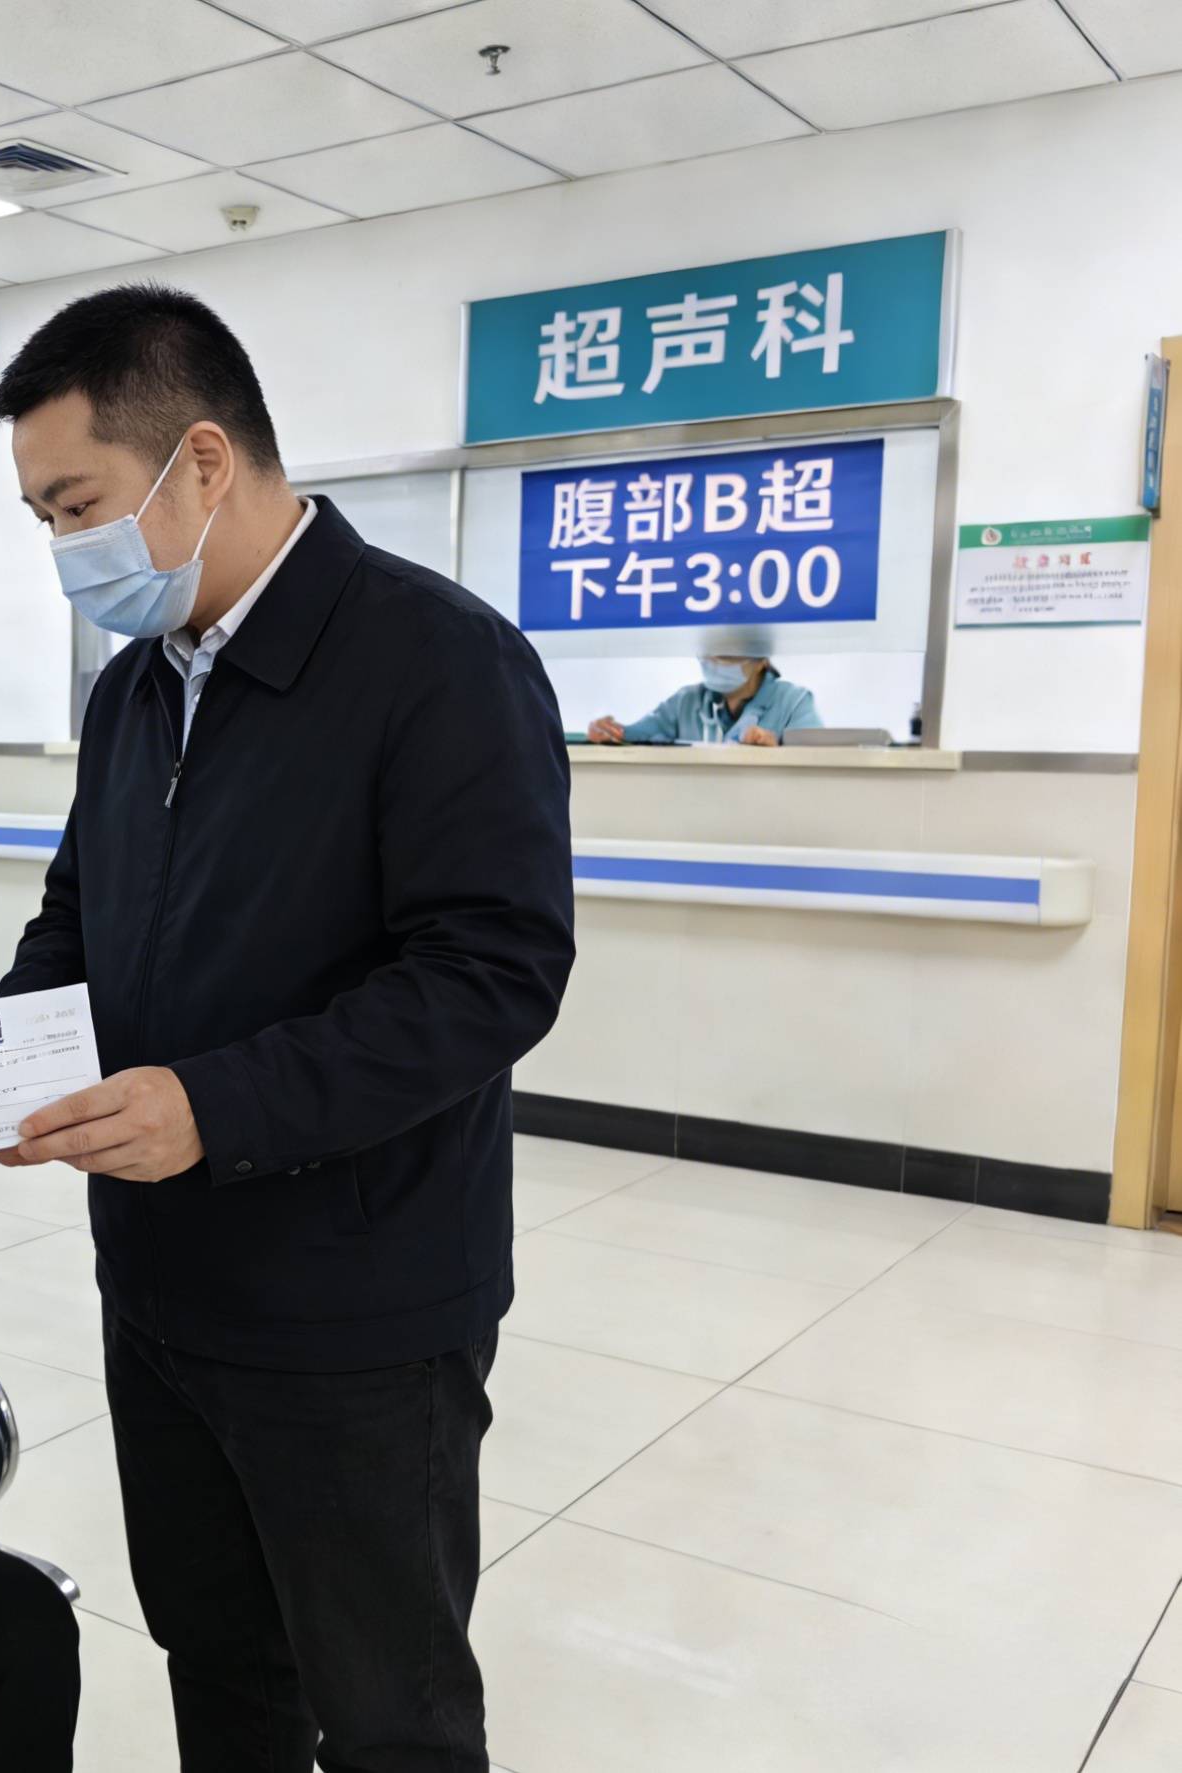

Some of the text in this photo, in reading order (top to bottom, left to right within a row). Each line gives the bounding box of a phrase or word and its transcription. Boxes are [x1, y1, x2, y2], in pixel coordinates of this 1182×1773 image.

[533, 272, 854, 404] 超声科
[549, 458, 834, 549] 腹部B超
[550, 545, 842, 620] 下午3:00
